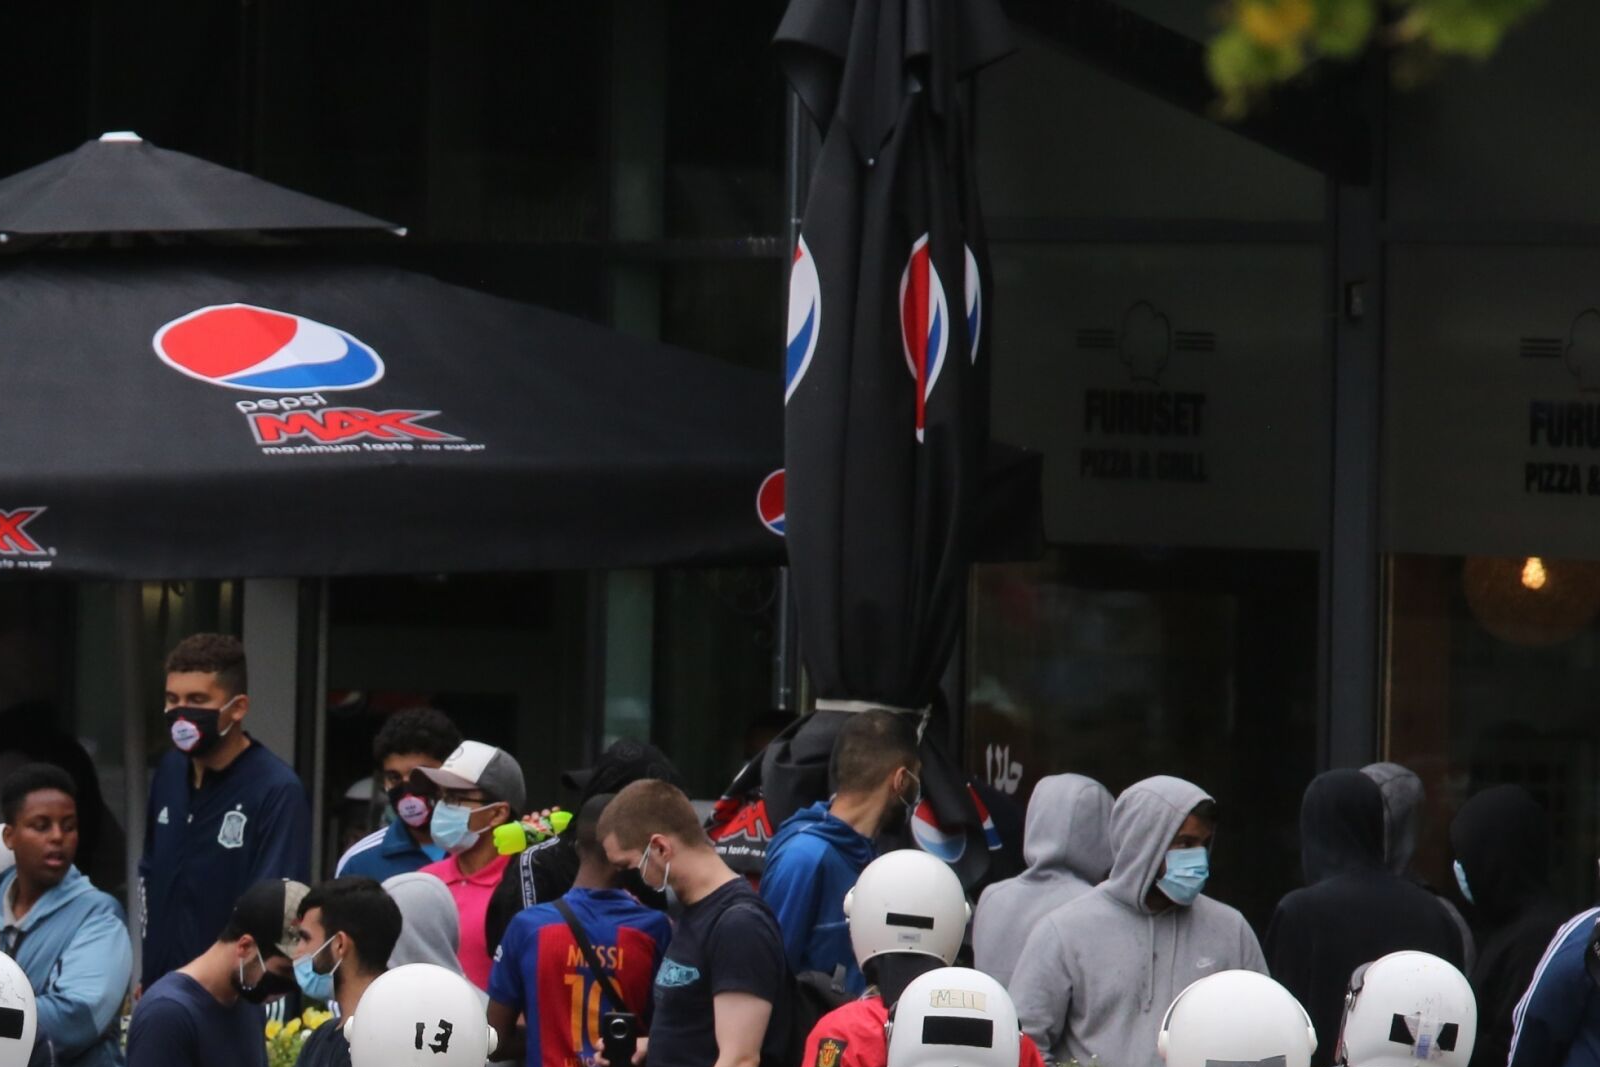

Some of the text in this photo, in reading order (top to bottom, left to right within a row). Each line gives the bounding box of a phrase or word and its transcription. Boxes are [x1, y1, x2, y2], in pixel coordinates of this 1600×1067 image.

[236, 392, 327, 414] pepsi
[1084, 388, 1206, 437] FURUSET
[246, 406, 466, 445] MAX
[262, 443, 360, 455] maximum
[362, 441, 413, 452] taste
[1080, 447, 1132, 480] PIZZA
[1157, 451, 1208, 481] GRILL
[1525, 461, 1582, 494] PIZZA
[566, 944, 623, 970] MSSI
[414, 1018, 453, 1055] 13
